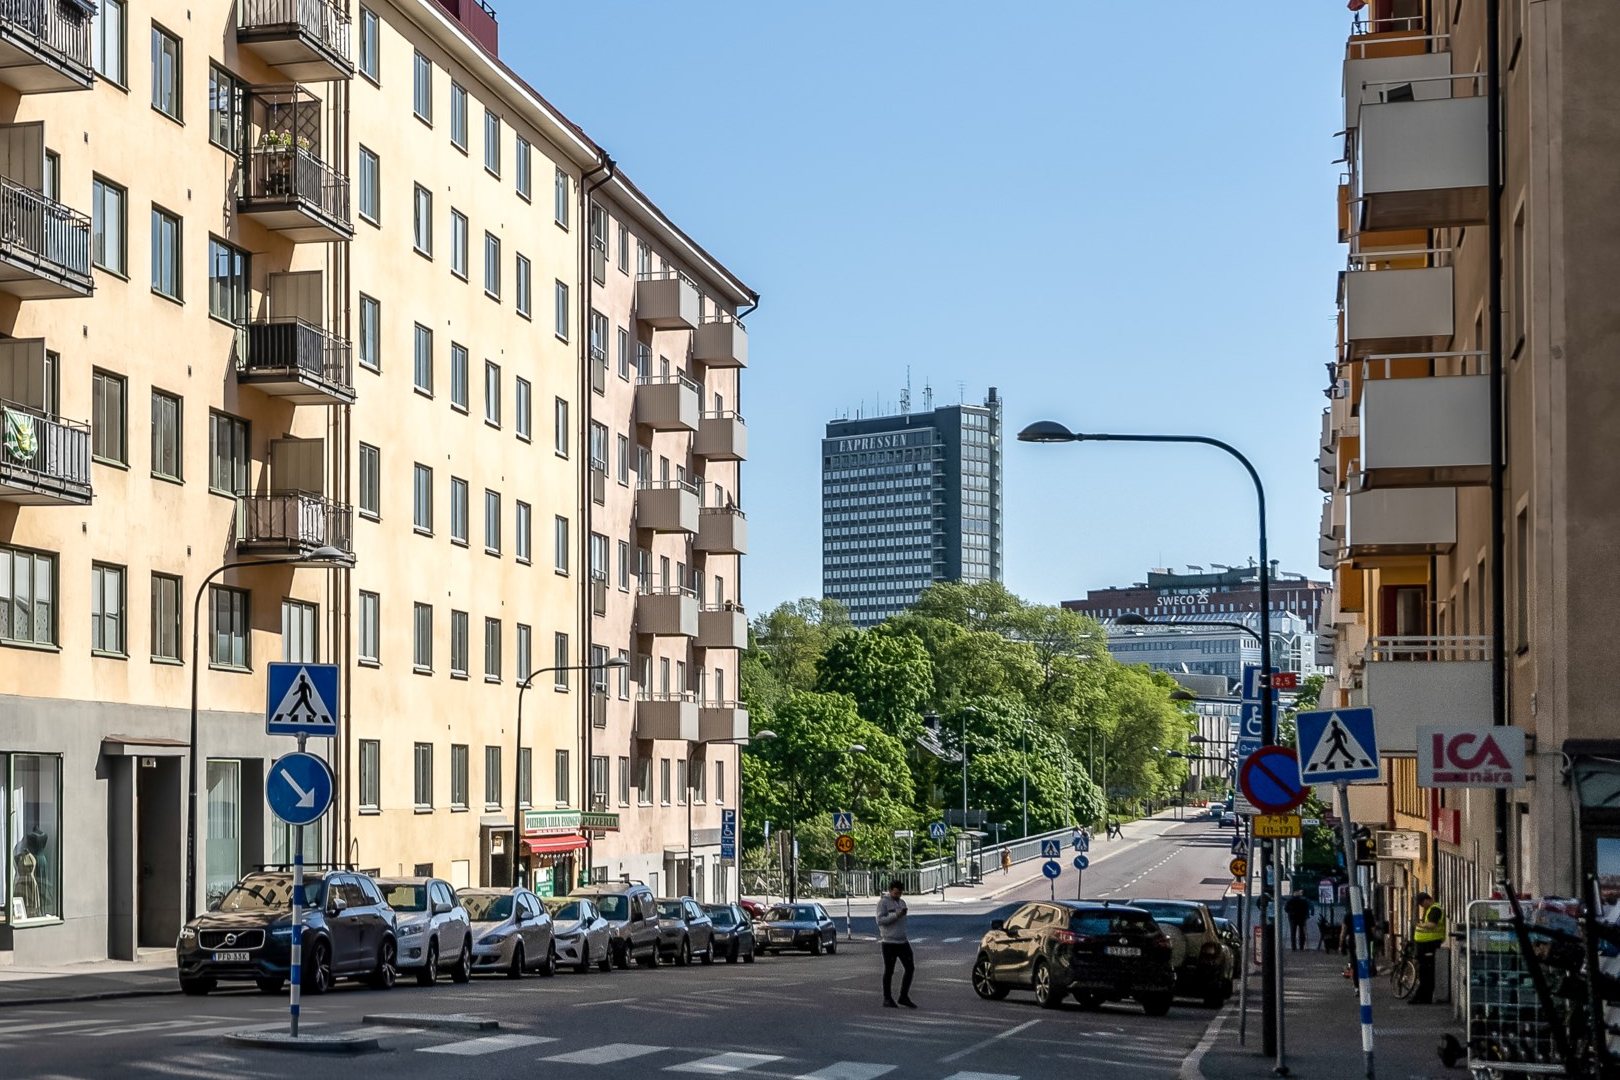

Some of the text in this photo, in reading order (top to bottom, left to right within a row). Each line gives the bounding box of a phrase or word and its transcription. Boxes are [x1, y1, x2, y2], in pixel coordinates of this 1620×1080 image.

[839, 434, 907, 452] EXPRESSEN
[1157, 595, 1195, 606] SWECO
[1432, 732, 1512, 769] ICA
[1469, 769, 1513, 783] nära
[582, 816, 617, 827] PIZZERIA
[725, 811, 733, 821] P
[838, 840, 851, 849] 40
[1233, 864, 1248, 872] 40
